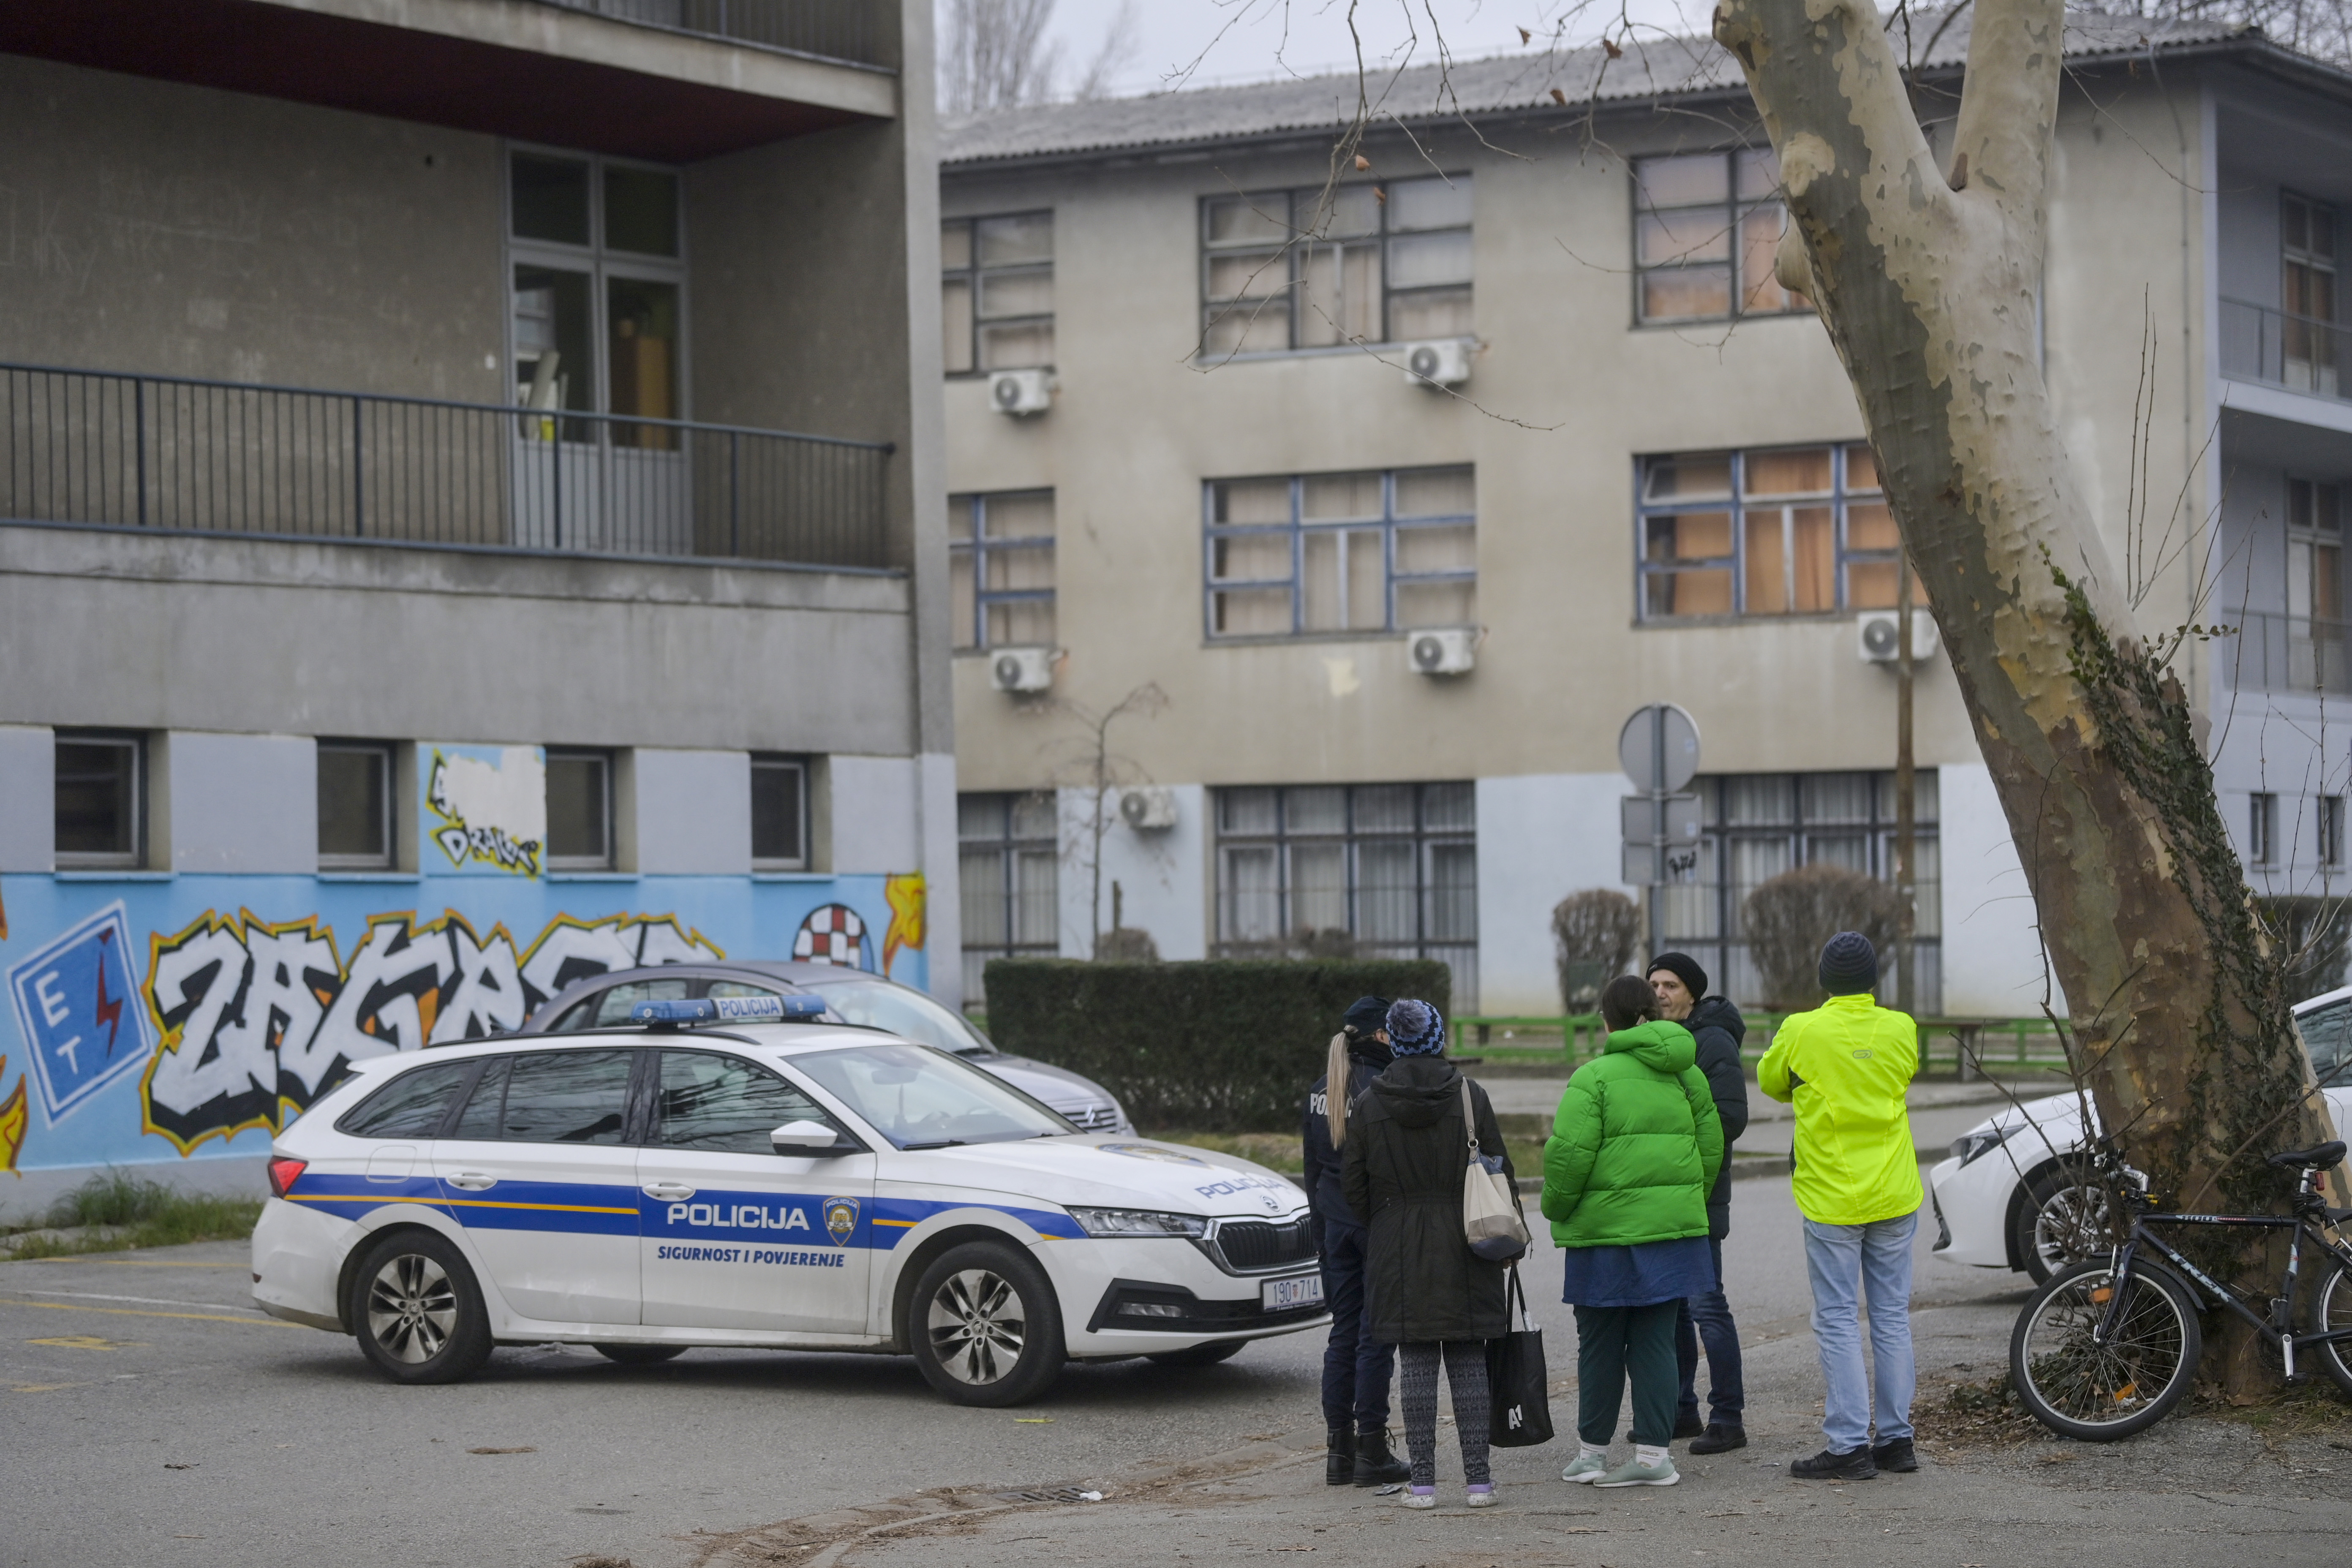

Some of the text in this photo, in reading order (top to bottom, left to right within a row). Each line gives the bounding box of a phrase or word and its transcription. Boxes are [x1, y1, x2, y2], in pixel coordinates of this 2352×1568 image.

[720, 999, 779, 1016] POLICIJA
[667, 1203, 810, 1230] POLICIJA
[826, 1199, 857, 1209] POLICIJA
[658, 1246, 845, 1267] SIGURNOST I POVJERENJE
[2169, 1249, 2233, 1302] TREK
[1274, 1278, 1318, 1304] 190 714
[1508, 1404, 1523, 1430] A1
